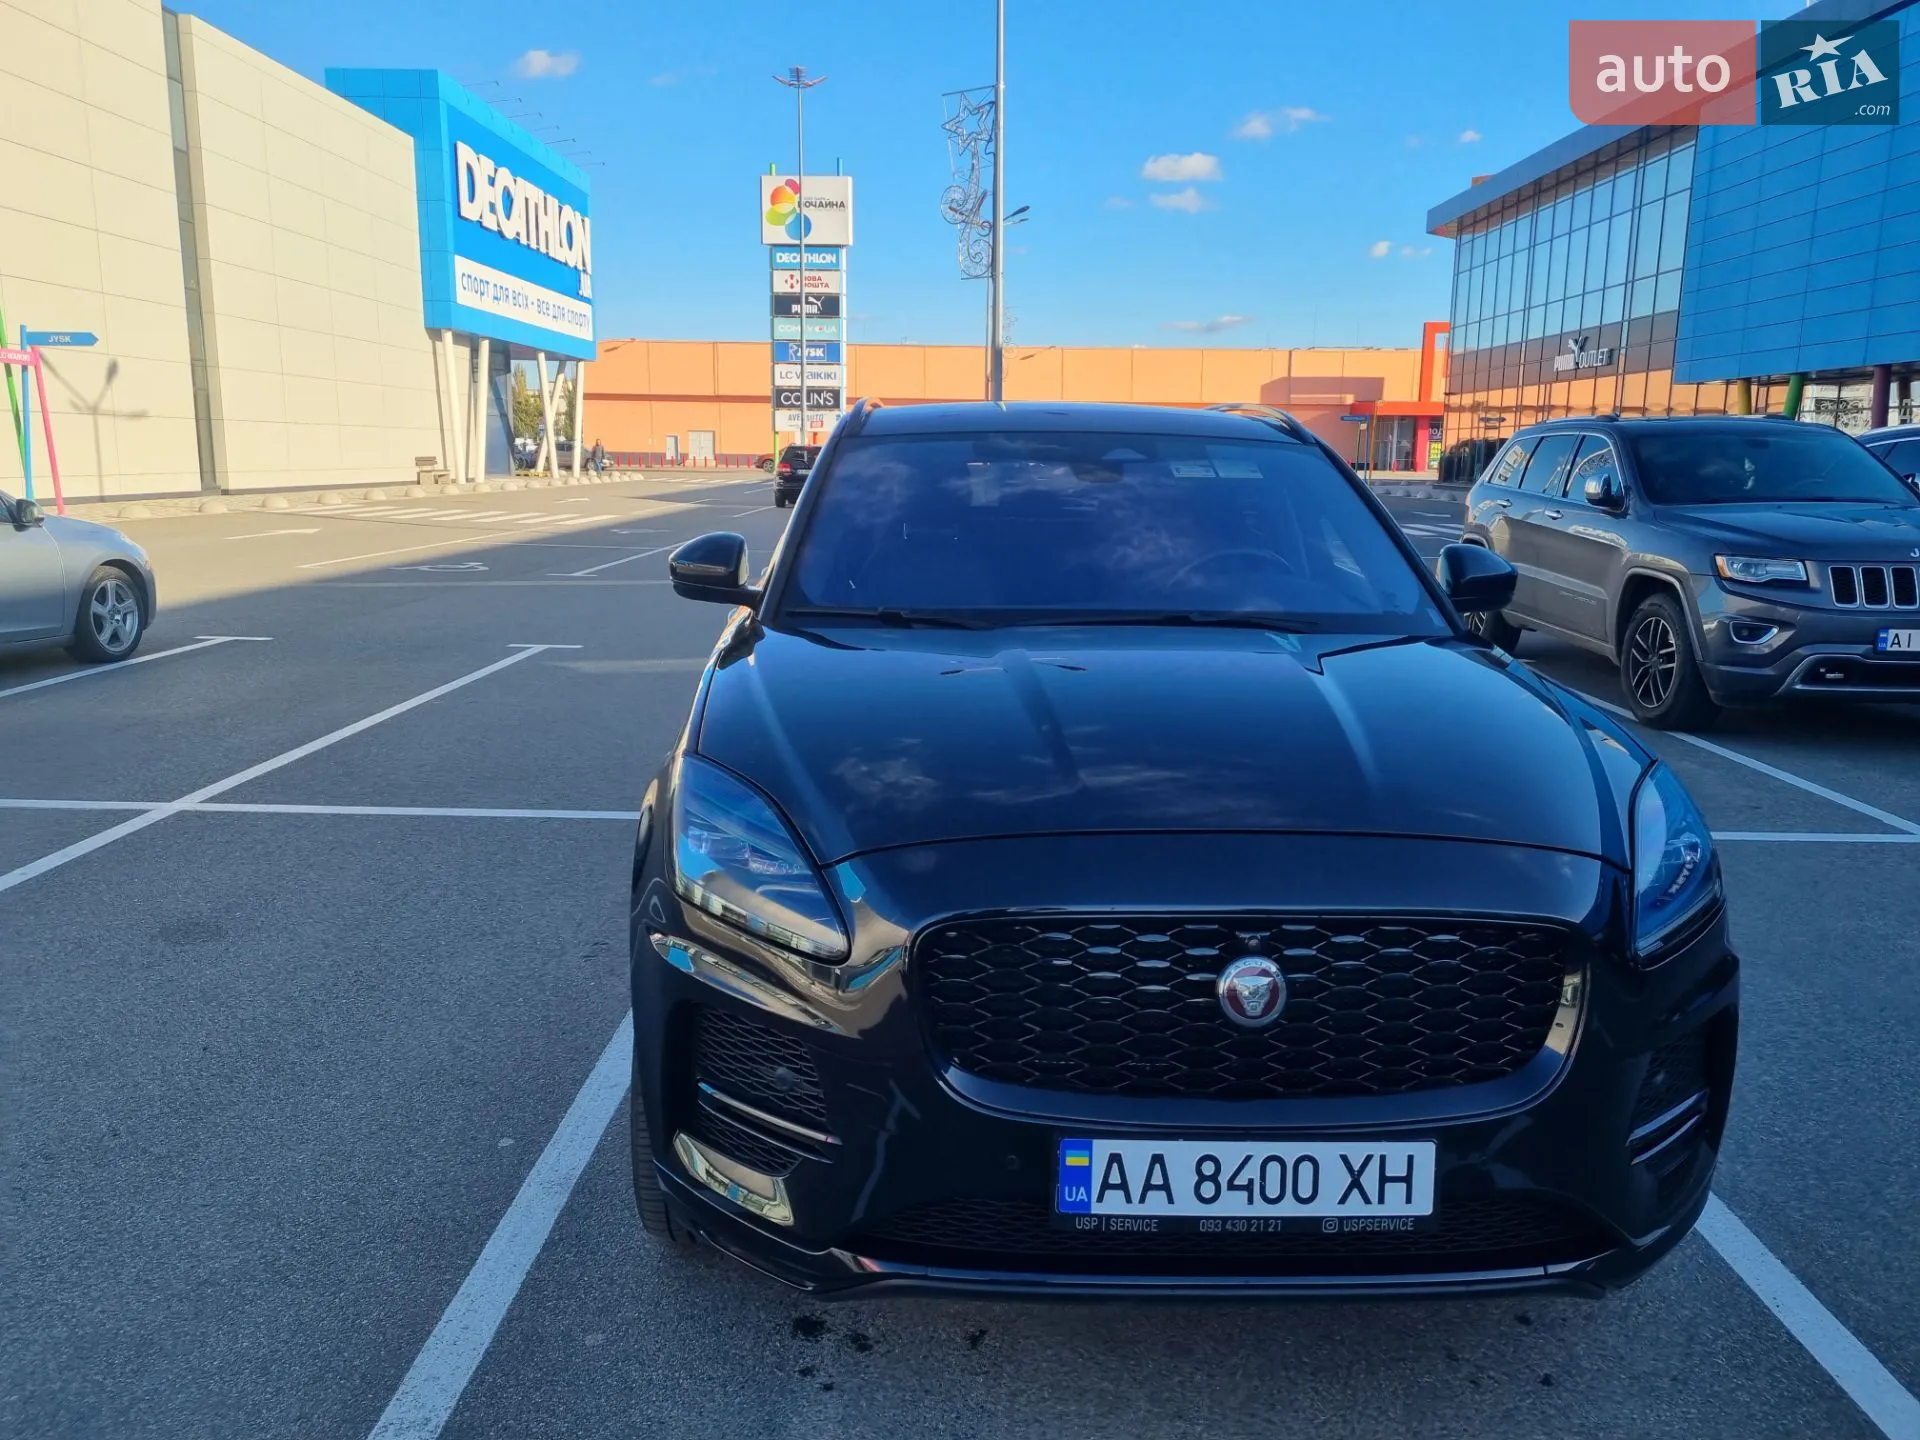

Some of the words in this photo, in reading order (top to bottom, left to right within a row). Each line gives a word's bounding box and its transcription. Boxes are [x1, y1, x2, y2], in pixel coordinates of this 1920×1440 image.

[456, 140, 592, 275] DECATHLON
[776, 252, 836, 264] DECTHLON
[461, 272, 490, 302] спорт
[492, 283, 510, 305] для
[512, 287, 529, 309] всіх
[537, 298, 550, 317] все
[552, 304, 566, 322] для
[778, 324, 813, 333] COMY
[48, 335, 72, 343] JYSK
[1578, 347, 1609, 369] OUTLET
[780, 370, 793, 380] LC
[780, 390, 834, 406] COIN'S
[1064, 1186, 1088, 1202] UA
[1095, 1152, 1175, 1205] AA
[1193, 1153, 1320, 1206] 8400
[1337, 1153, 1415, 1206] XH
[1075, 1217, 1098, 1230] USP
[1110, 1218, 1159, 1232] SERVICE
[1200, 1219, 1222, 1232] 093
[1225, 1219, 1247, 1232] 430
[1250, 1219, 1264, 1232] 21
[1267, 1219, 1282, 1232] 21
[1343, 1217, 1415, 1232] USPSERVICE
